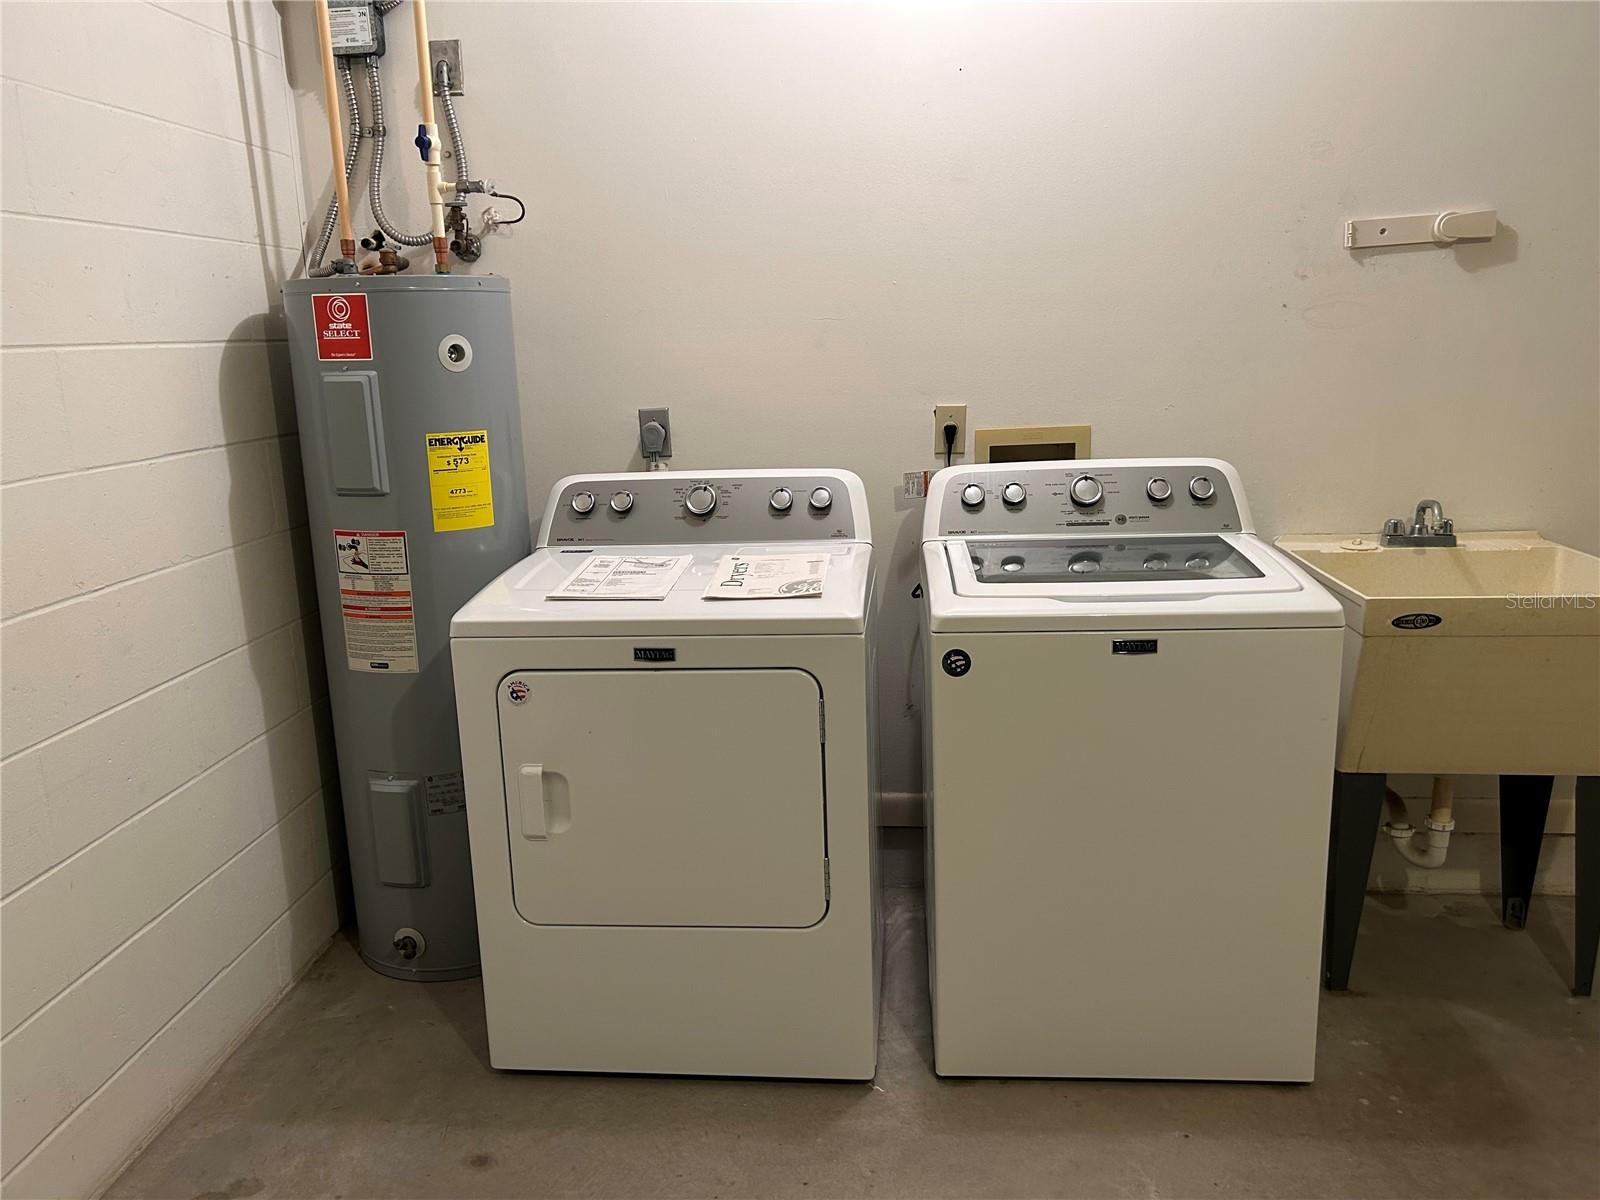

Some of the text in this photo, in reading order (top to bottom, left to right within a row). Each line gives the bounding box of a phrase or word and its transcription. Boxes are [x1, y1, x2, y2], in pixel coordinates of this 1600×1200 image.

[328, 322, 353, 330] state
[323, 329, 361, 337] SELECT
[428, 434, 486, 447] ENERGYGUIDE
[452, 457, 470, 465] 573
[635, 649, 673, 659] MAYTAG
[507, 680, 530, 693] AMERICA
